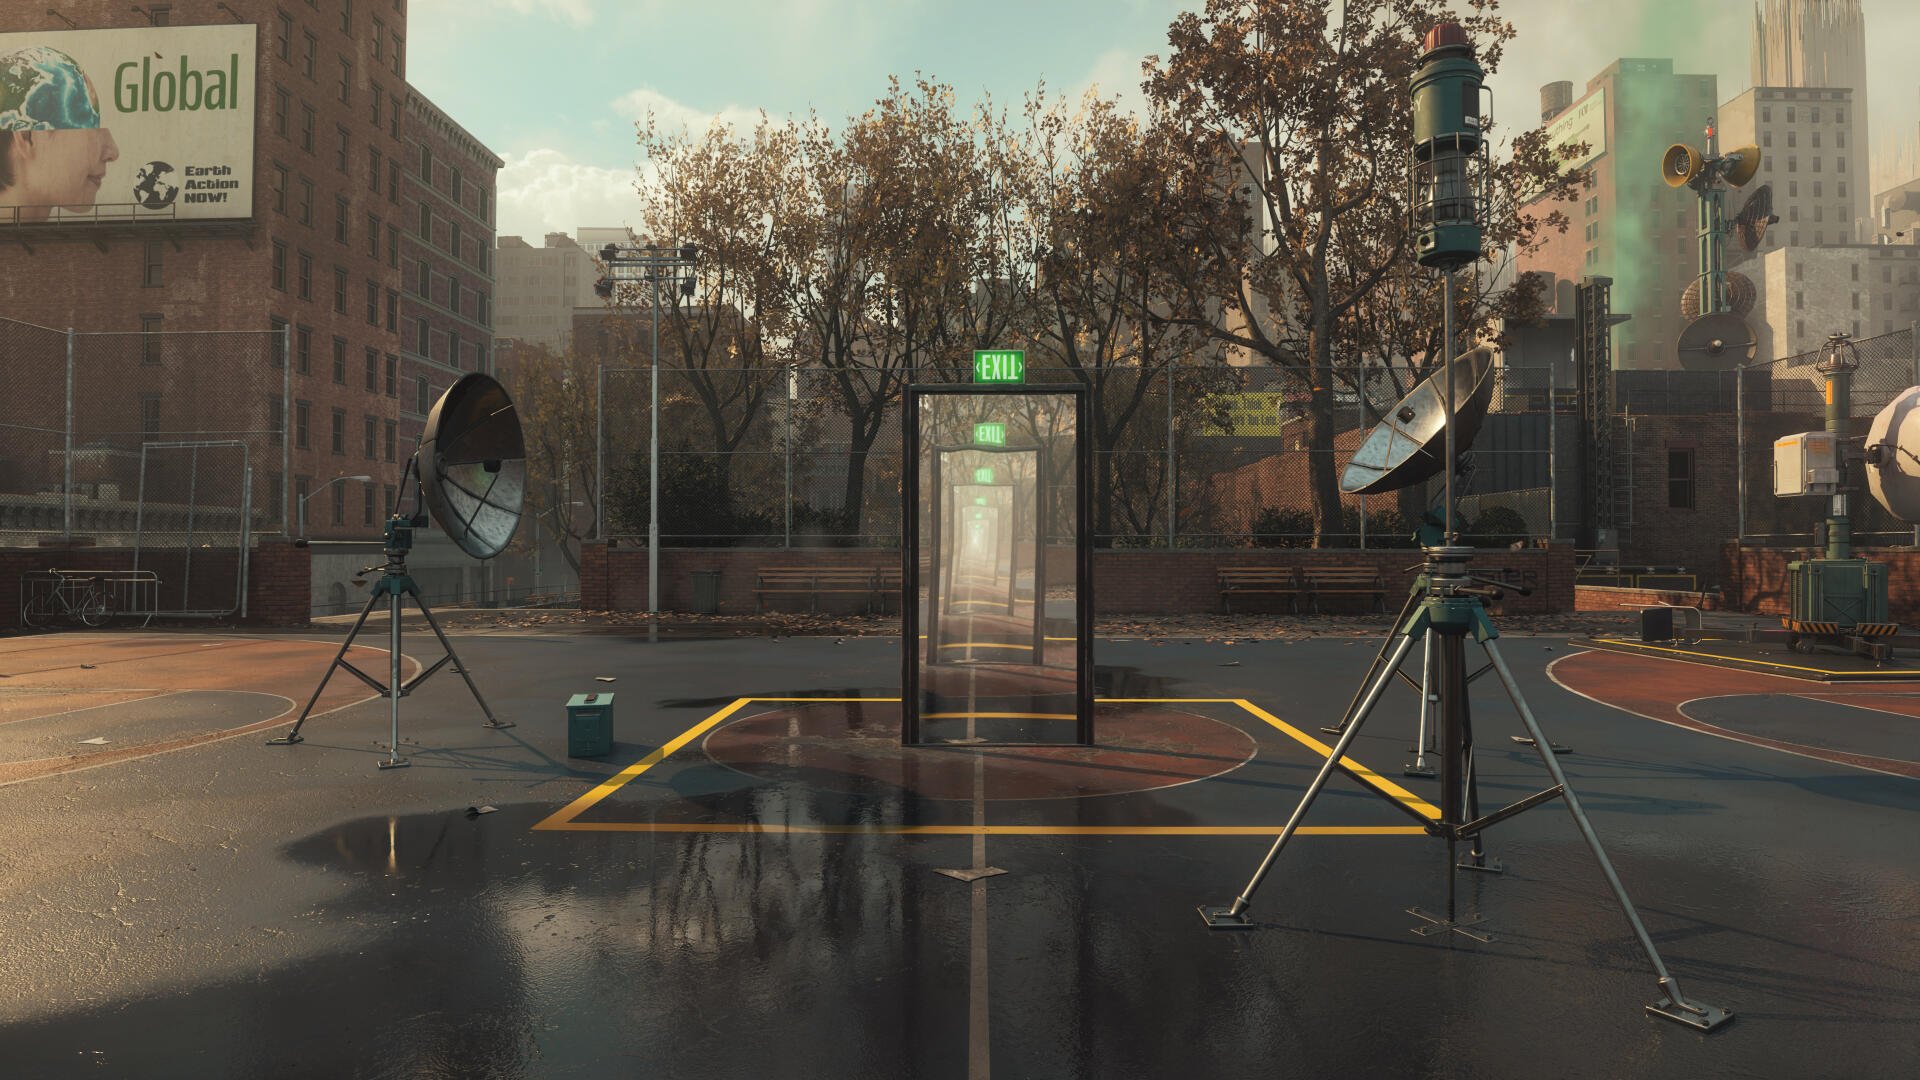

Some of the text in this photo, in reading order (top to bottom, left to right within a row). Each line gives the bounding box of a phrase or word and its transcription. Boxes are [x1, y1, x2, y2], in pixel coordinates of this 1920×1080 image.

[114, 53, 239, 113] Global
[185, 165, 232, 176] Earth
[185, 179, 239, 190] Action
[184, 192, 228, 203] NOW!
